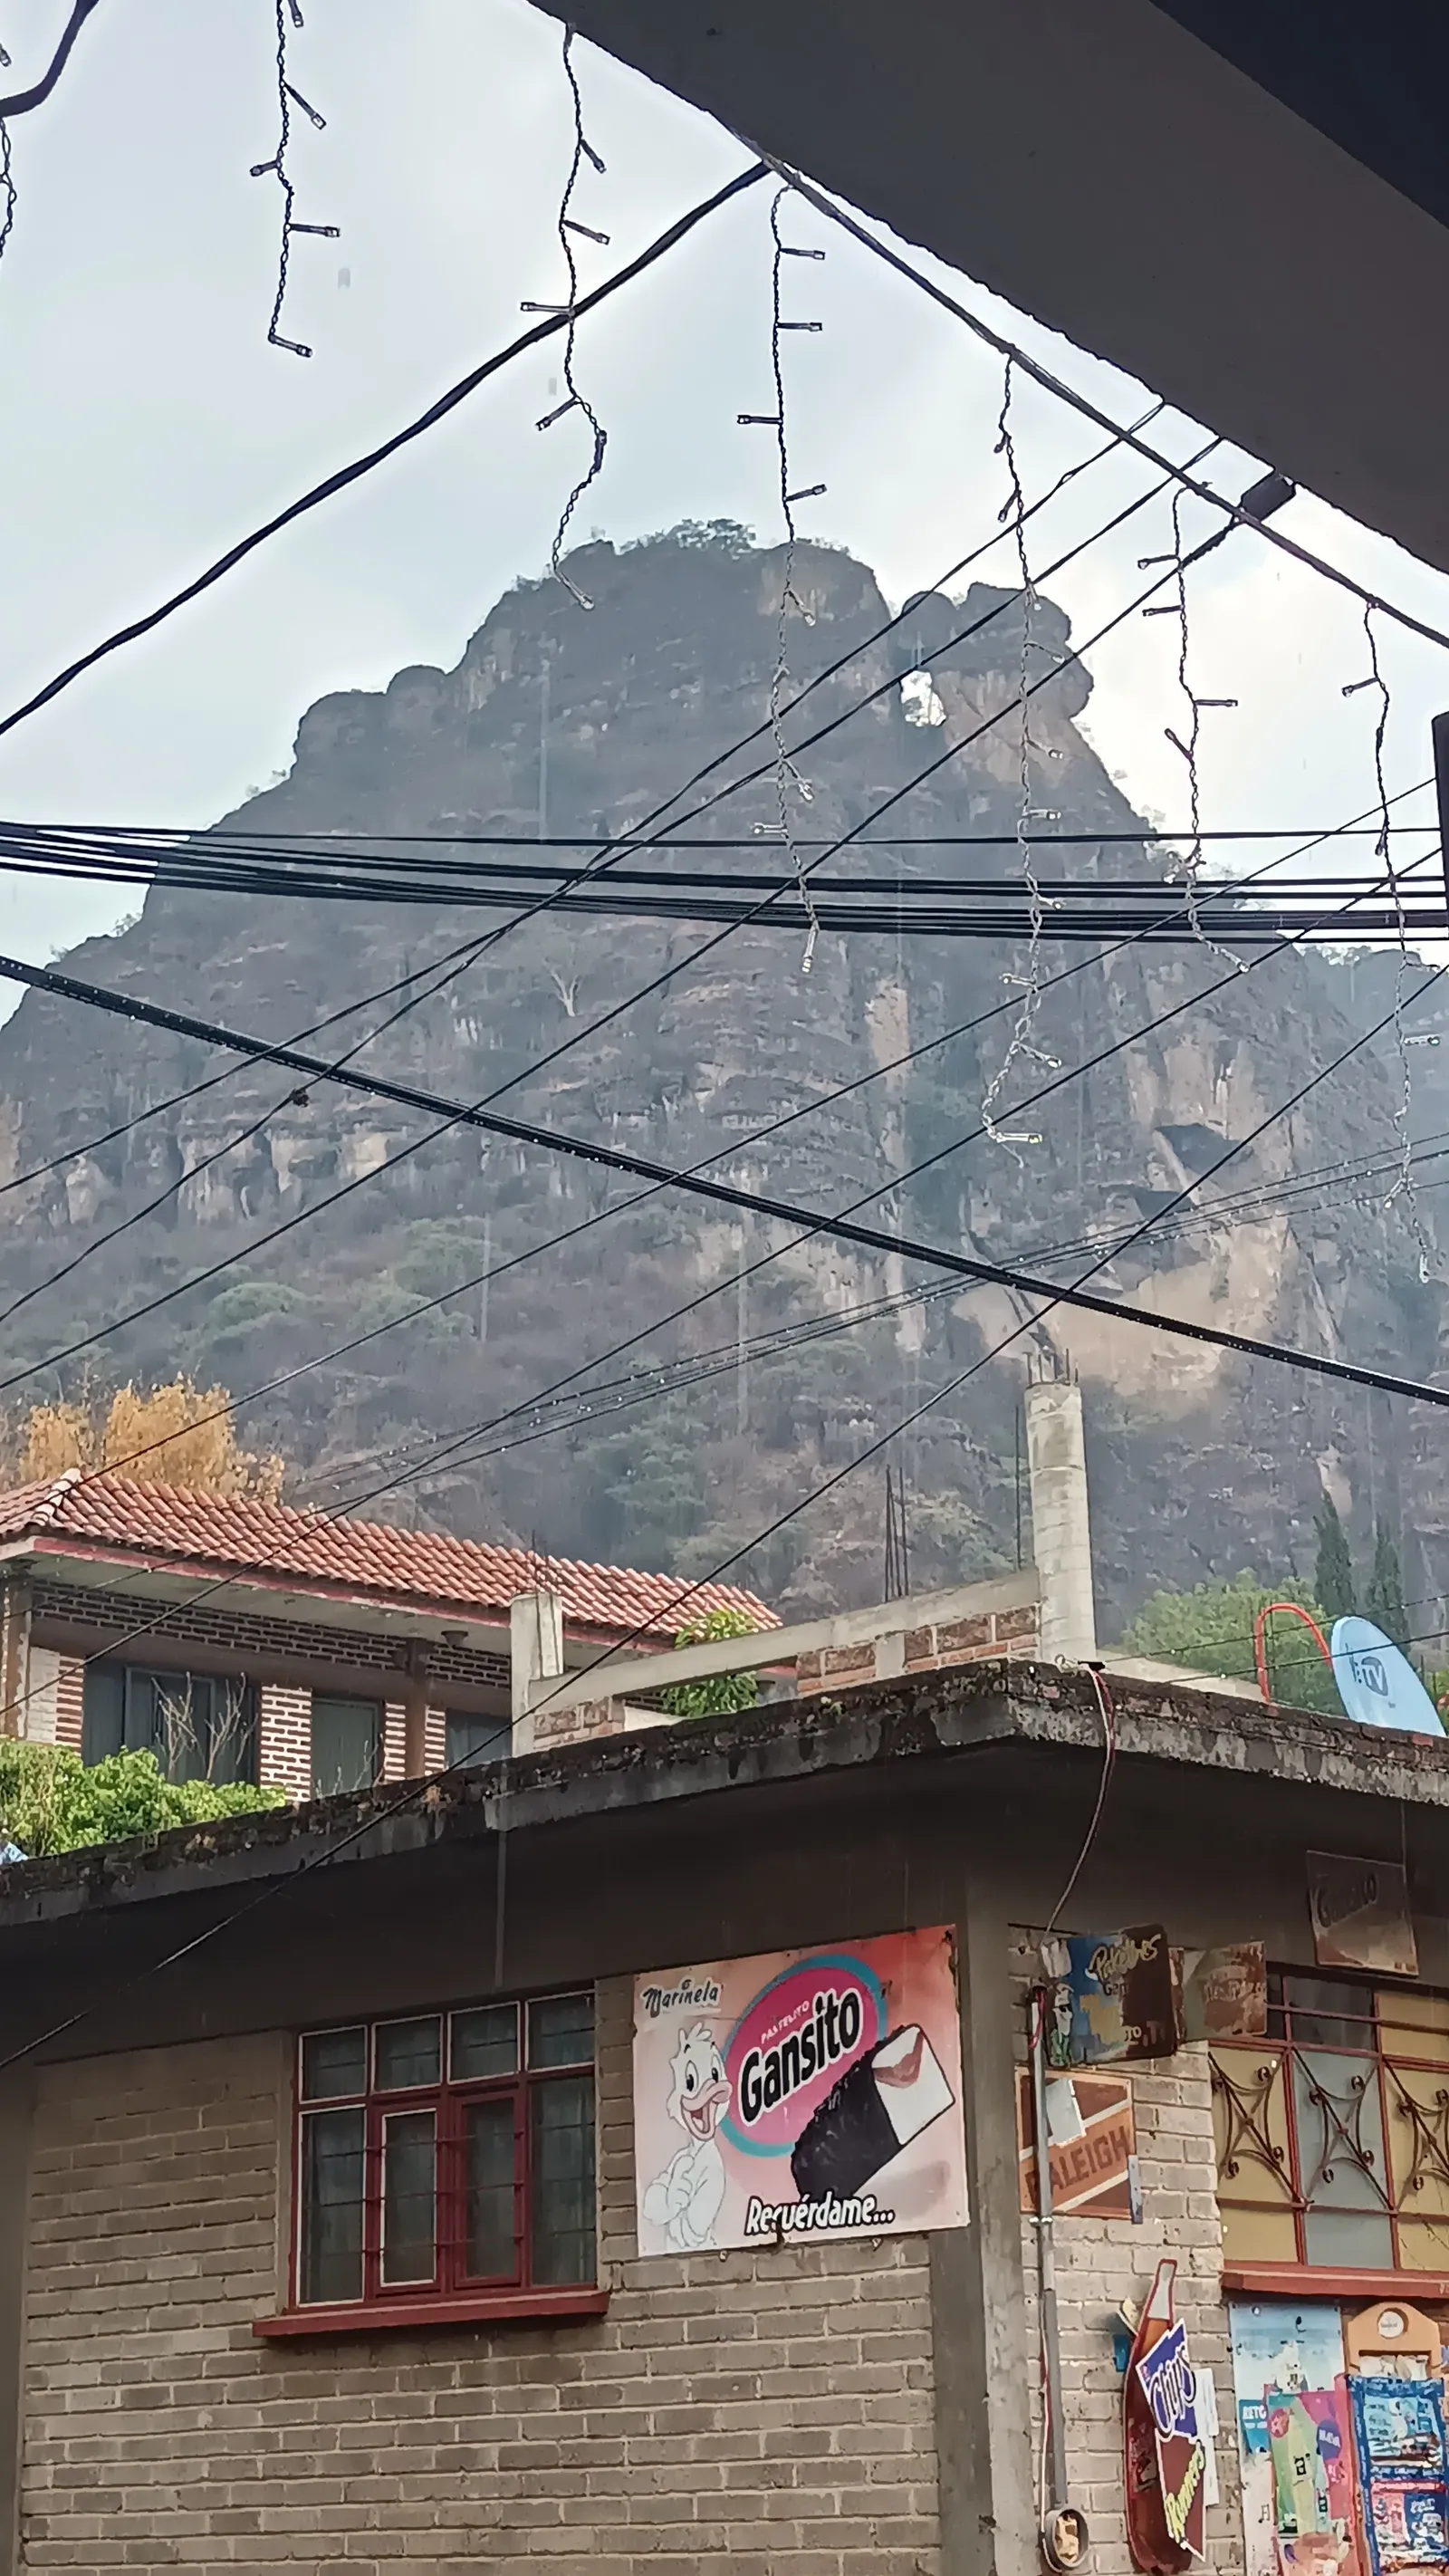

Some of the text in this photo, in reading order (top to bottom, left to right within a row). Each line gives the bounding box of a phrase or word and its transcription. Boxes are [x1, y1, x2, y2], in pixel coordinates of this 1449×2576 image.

[641, 1978, 719, 2019] Marinela
[760, 2000, 811, 2045] PASTELITO
[739, 1989, 862, 2124] Gansito
